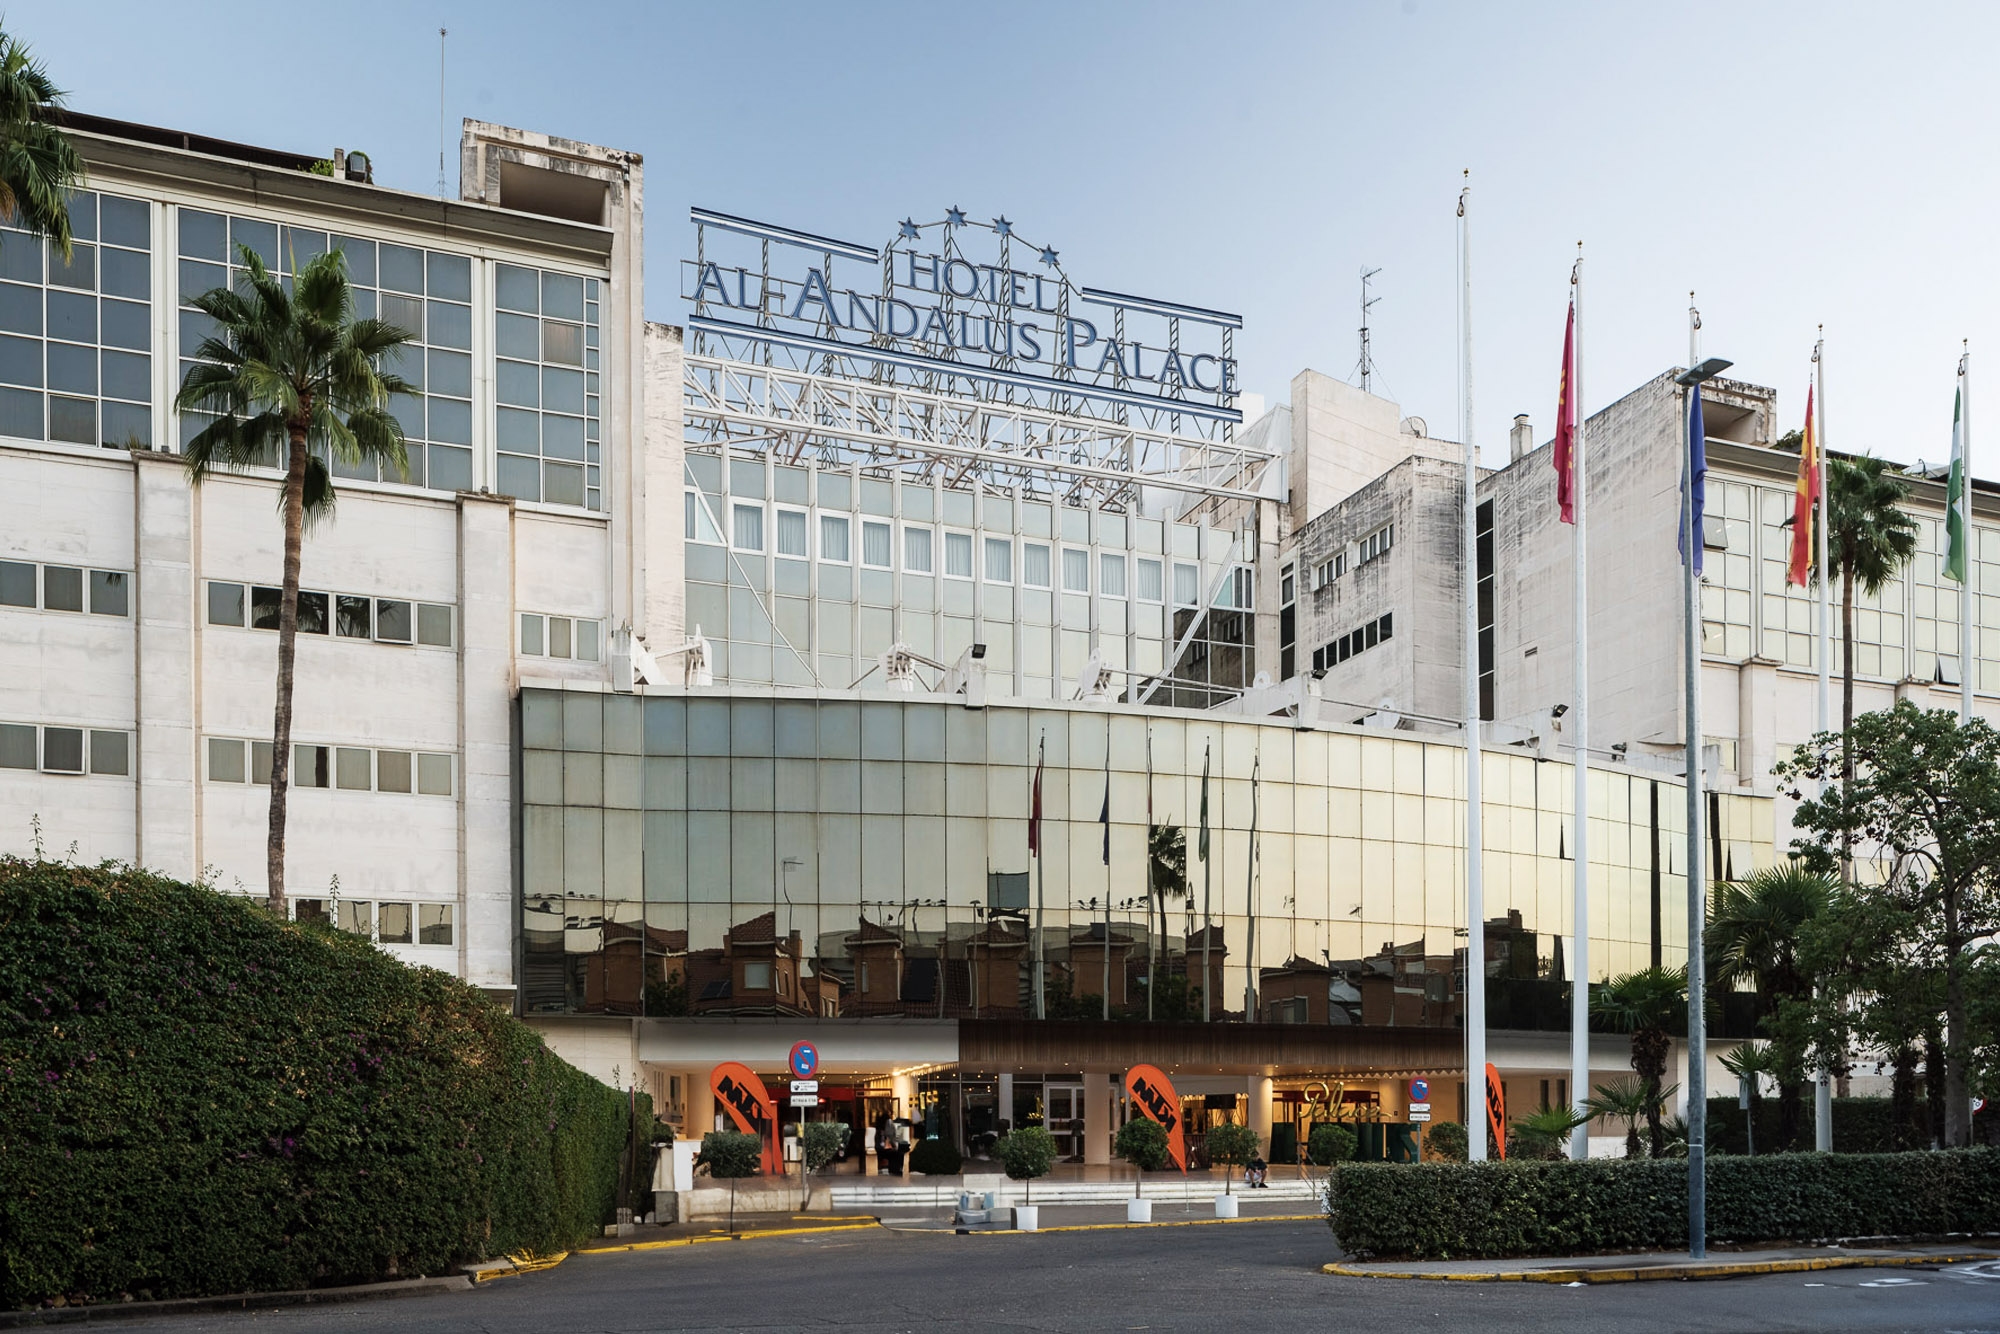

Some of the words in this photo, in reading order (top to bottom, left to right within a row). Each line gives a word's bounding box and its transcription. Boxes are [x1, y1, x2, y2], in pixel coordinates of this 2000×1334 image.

[906, 249, 1057, 313] HOTEL
[1065, 317, 1241, 397] PALACE
[1299, 1081, 1392, 1119] Palace
